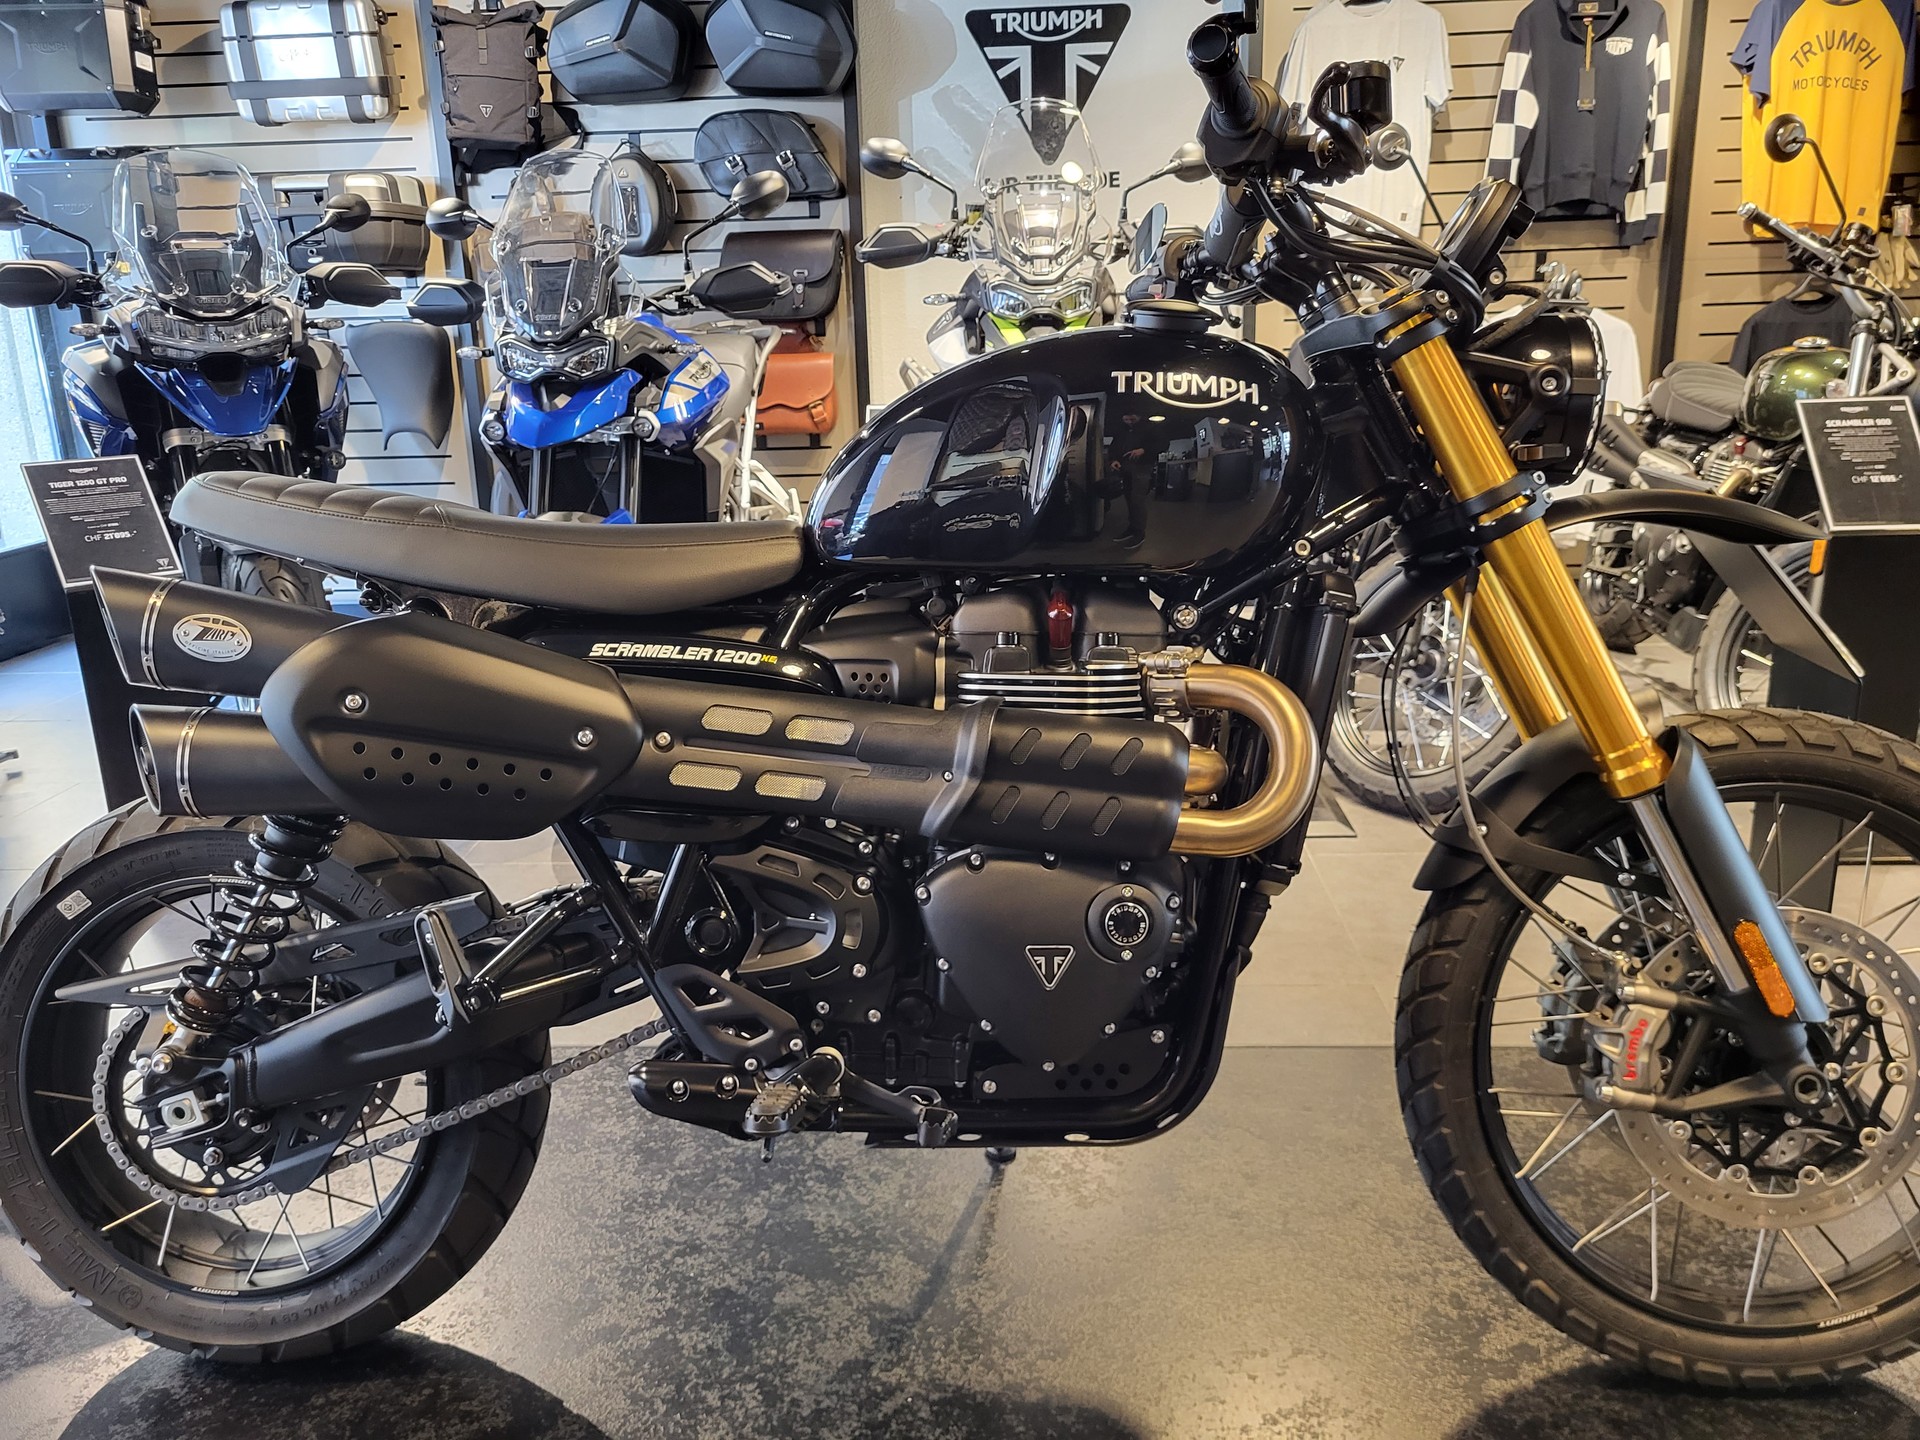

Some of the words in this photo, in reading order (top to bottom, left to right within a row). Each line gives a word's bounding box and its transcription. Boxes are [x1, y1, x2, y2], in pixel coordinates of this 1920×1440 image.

[990, 8, 1103, 42] TRIUMPH
[1789, 29, 1883, 70] TRIUMPH
[1792, 75, 1870, 92] MOTOCYCLES
[1111, 371, 1260, 409] TRIUMPH
[48, 480, 75, 489] TIGER
[96, 477, 108, 485] GT
[108, 476, 128, 484] PRO
[84, 534, 102, 542] CHF
[191, 625, 238, 642] ZARD
[588, 643, 714, 661] SCRAMBLER
[714, 649, 762, 666] 1200
[1111, 905, 1142, 918] TRIUMPH
[1621, 1018, 1649, 1081] brembo
